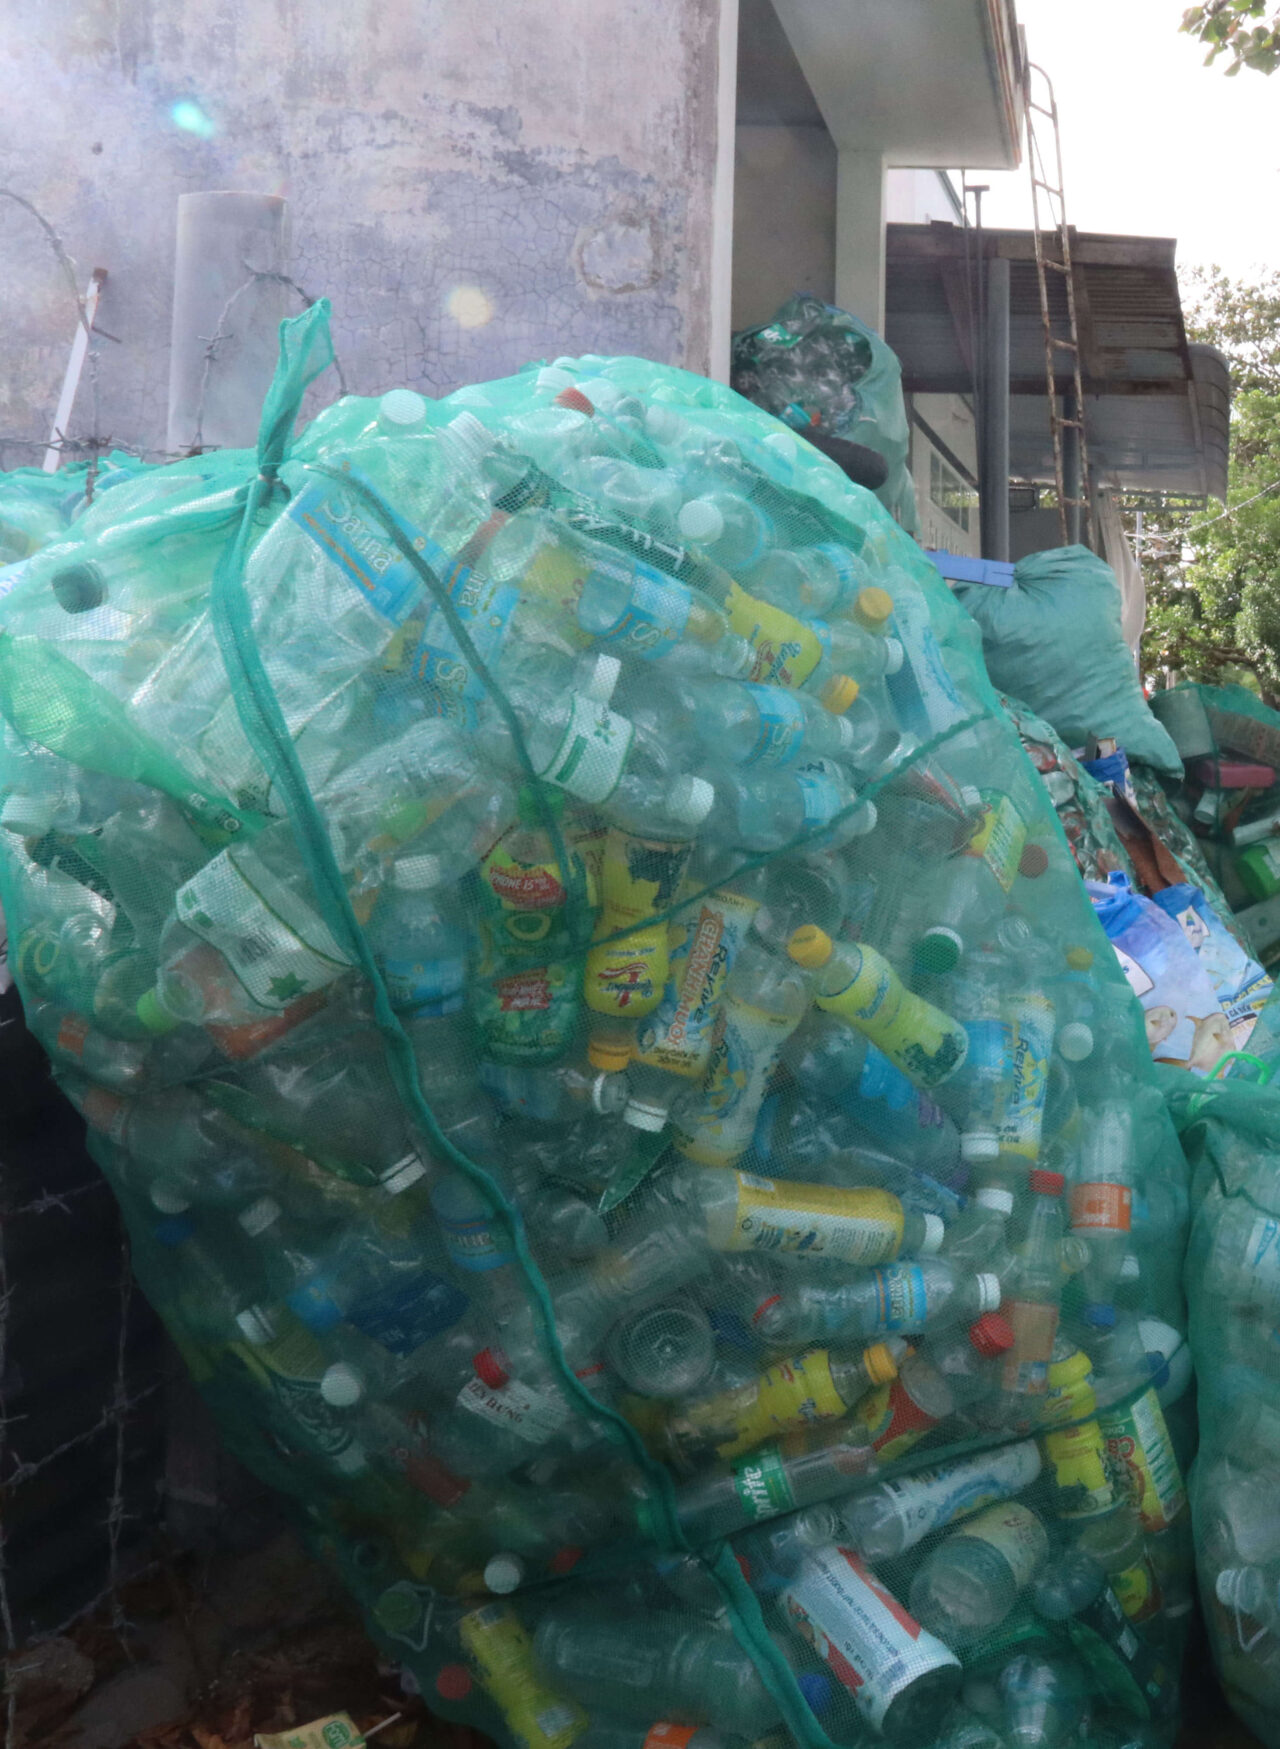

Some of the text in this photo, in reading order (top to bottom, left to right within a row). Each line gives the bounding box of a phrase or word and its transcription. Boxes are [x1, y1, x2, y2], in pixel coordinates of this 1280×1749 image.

[684, 918, 719, 998] CHANH
[693, 943, 729, 1024] Revive
[1012, 1038, 1029, 1105] Revive
[887, 1269, 904, 1322] Sanna
